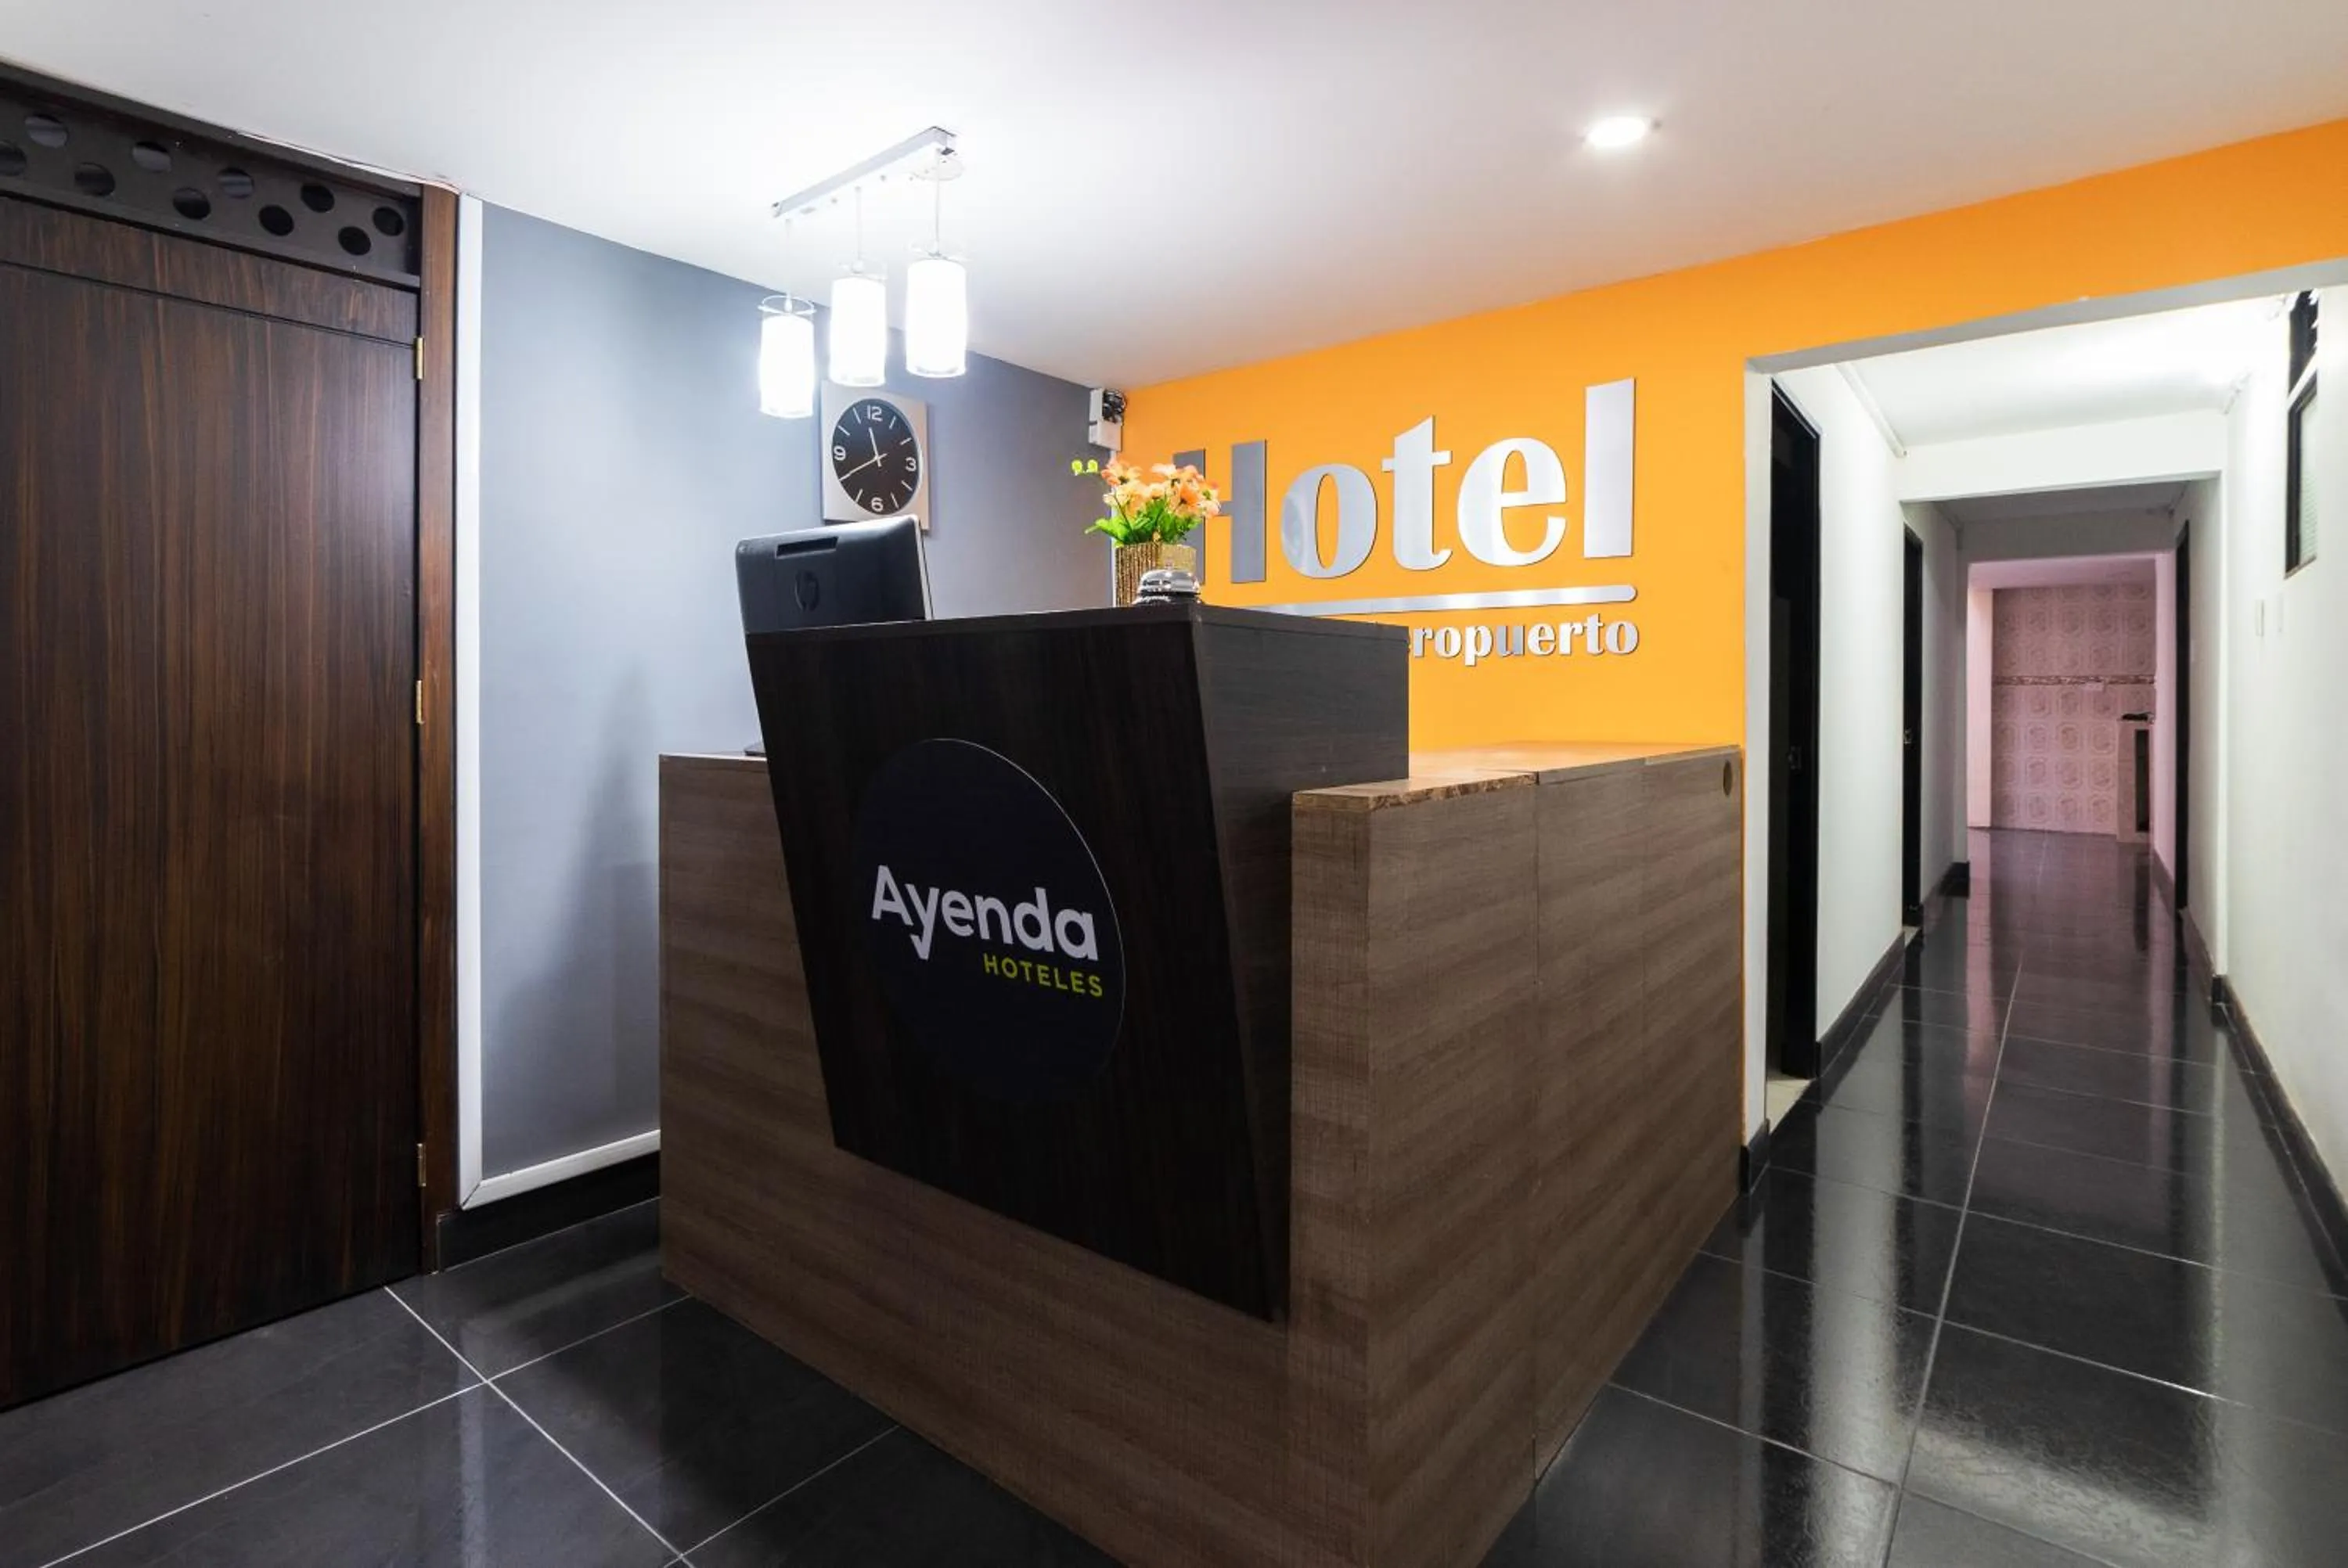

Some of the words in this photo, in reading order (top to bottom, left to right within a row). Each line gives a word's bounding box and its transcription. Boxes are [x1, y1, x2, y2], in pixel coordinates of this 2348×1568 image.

[866, 405, 883, 422] 12
[834, 445, 846, 461] 9
[905, 456, 917, 472] 3
[1172, 377, 1636, 585] Hotel
[870, 497, 884, 512] 6
[1406, 613, 1639, 666] ropuerto
[872, 865, 1098, 961] Ayenda
[983, 952, 1104, 997] HOTELES
